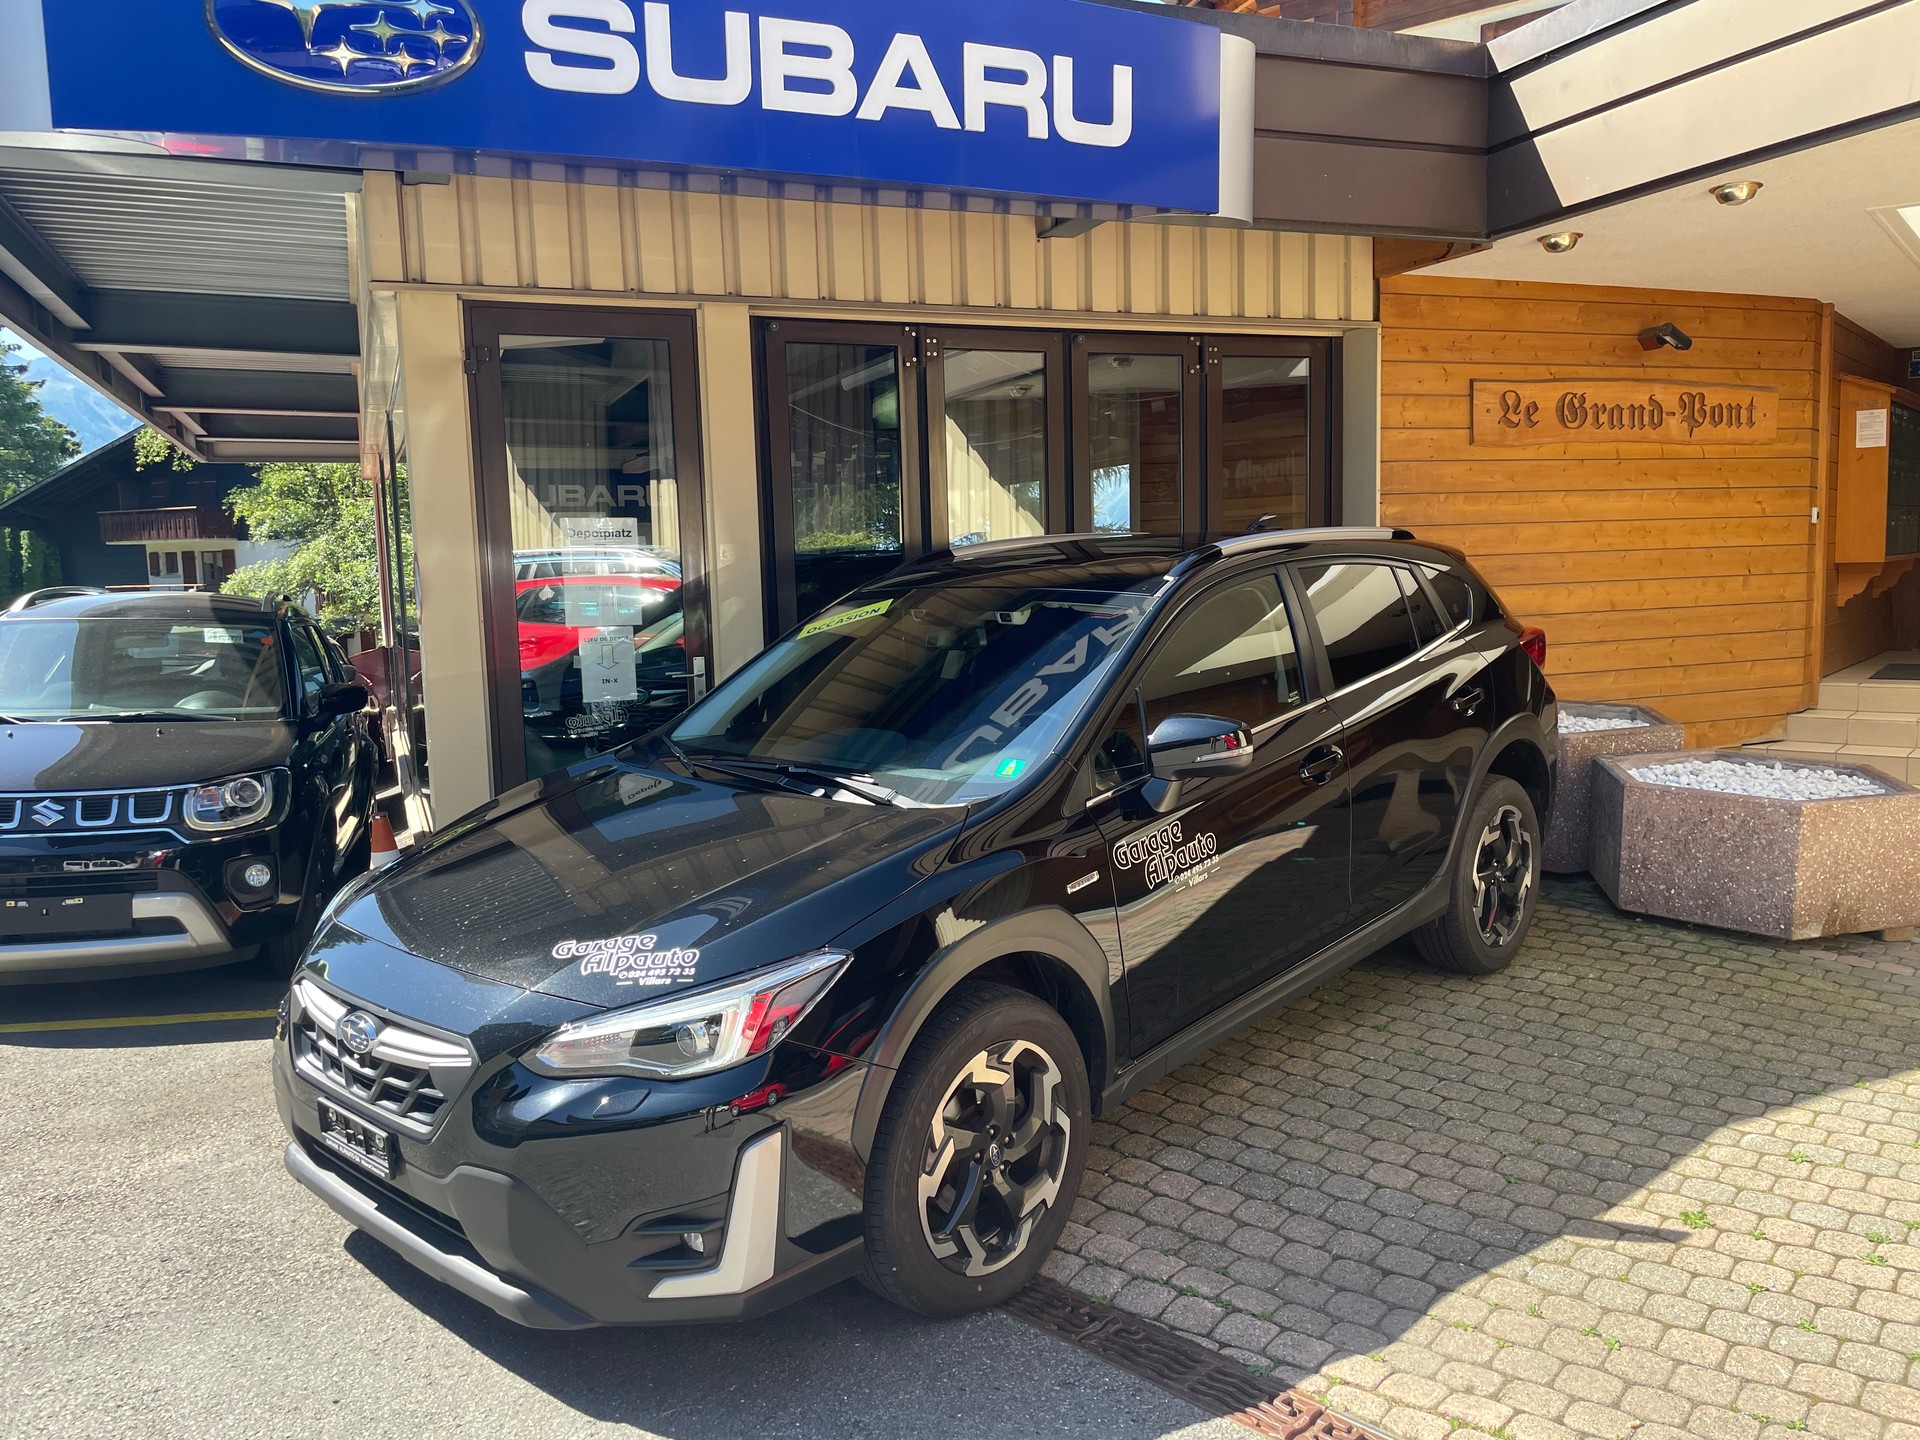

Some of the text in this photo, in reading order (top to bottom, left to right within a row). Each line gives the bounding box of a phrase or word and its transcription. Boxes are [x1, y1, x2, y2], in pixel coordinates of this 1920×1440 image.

[522, 0, 1133, 148] SUBARU
[1498, 389, 1757, 438] Le Grand-Pont
[806, 607, 881, 634] OCCASION
[1112, 820, 1183, 870] Garage
[1144, 832, 1217, 890] Alpauto
[552, 934, 657, 959] Garage
[580, 947, 700, 976] Alpauto
[638, 976, 672, 986] Villars
